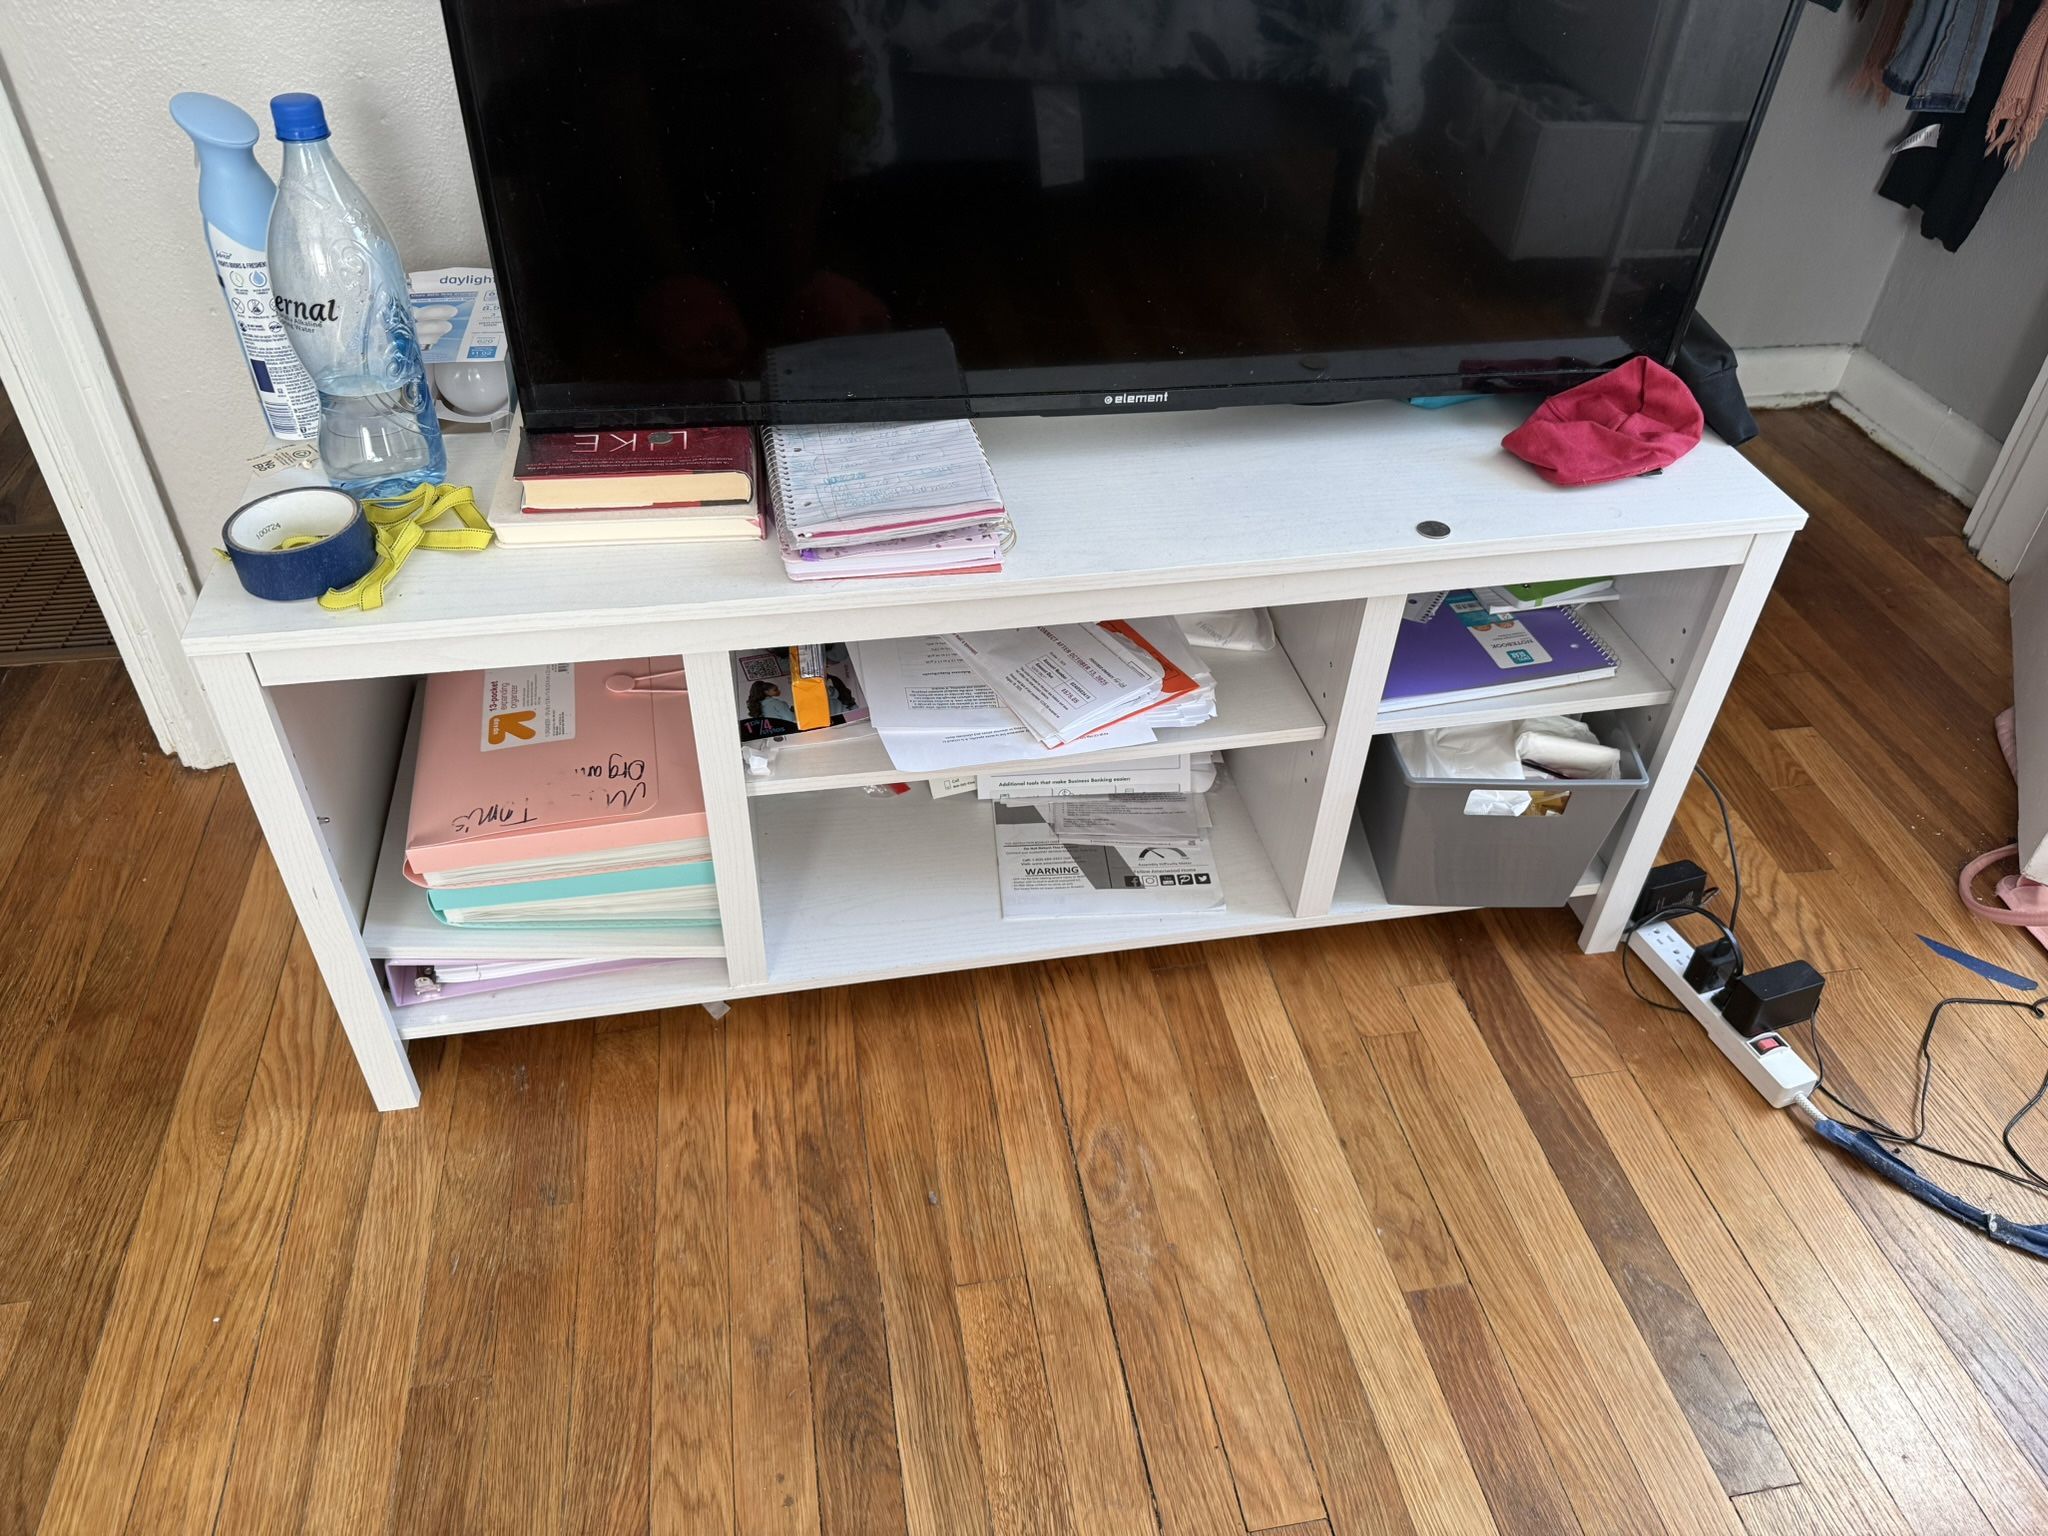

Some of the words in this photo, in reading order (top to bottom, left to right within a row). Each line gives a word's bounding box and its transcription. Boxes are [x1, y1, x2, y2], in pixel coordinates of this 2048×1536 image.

[440, 275, 495, 285] dayligh
[275, 295, 338, 321] ernal
[1114, 392, 1168, 404] element
[1068, 651, 1091, 670] OCTOBER
[489, 680, 498, 712] 13-pocket
[501, 682, 510, 710] expanding
[998, 780, 1026, 788] Additional
[1025, 866, 1079, 875] WARNING
